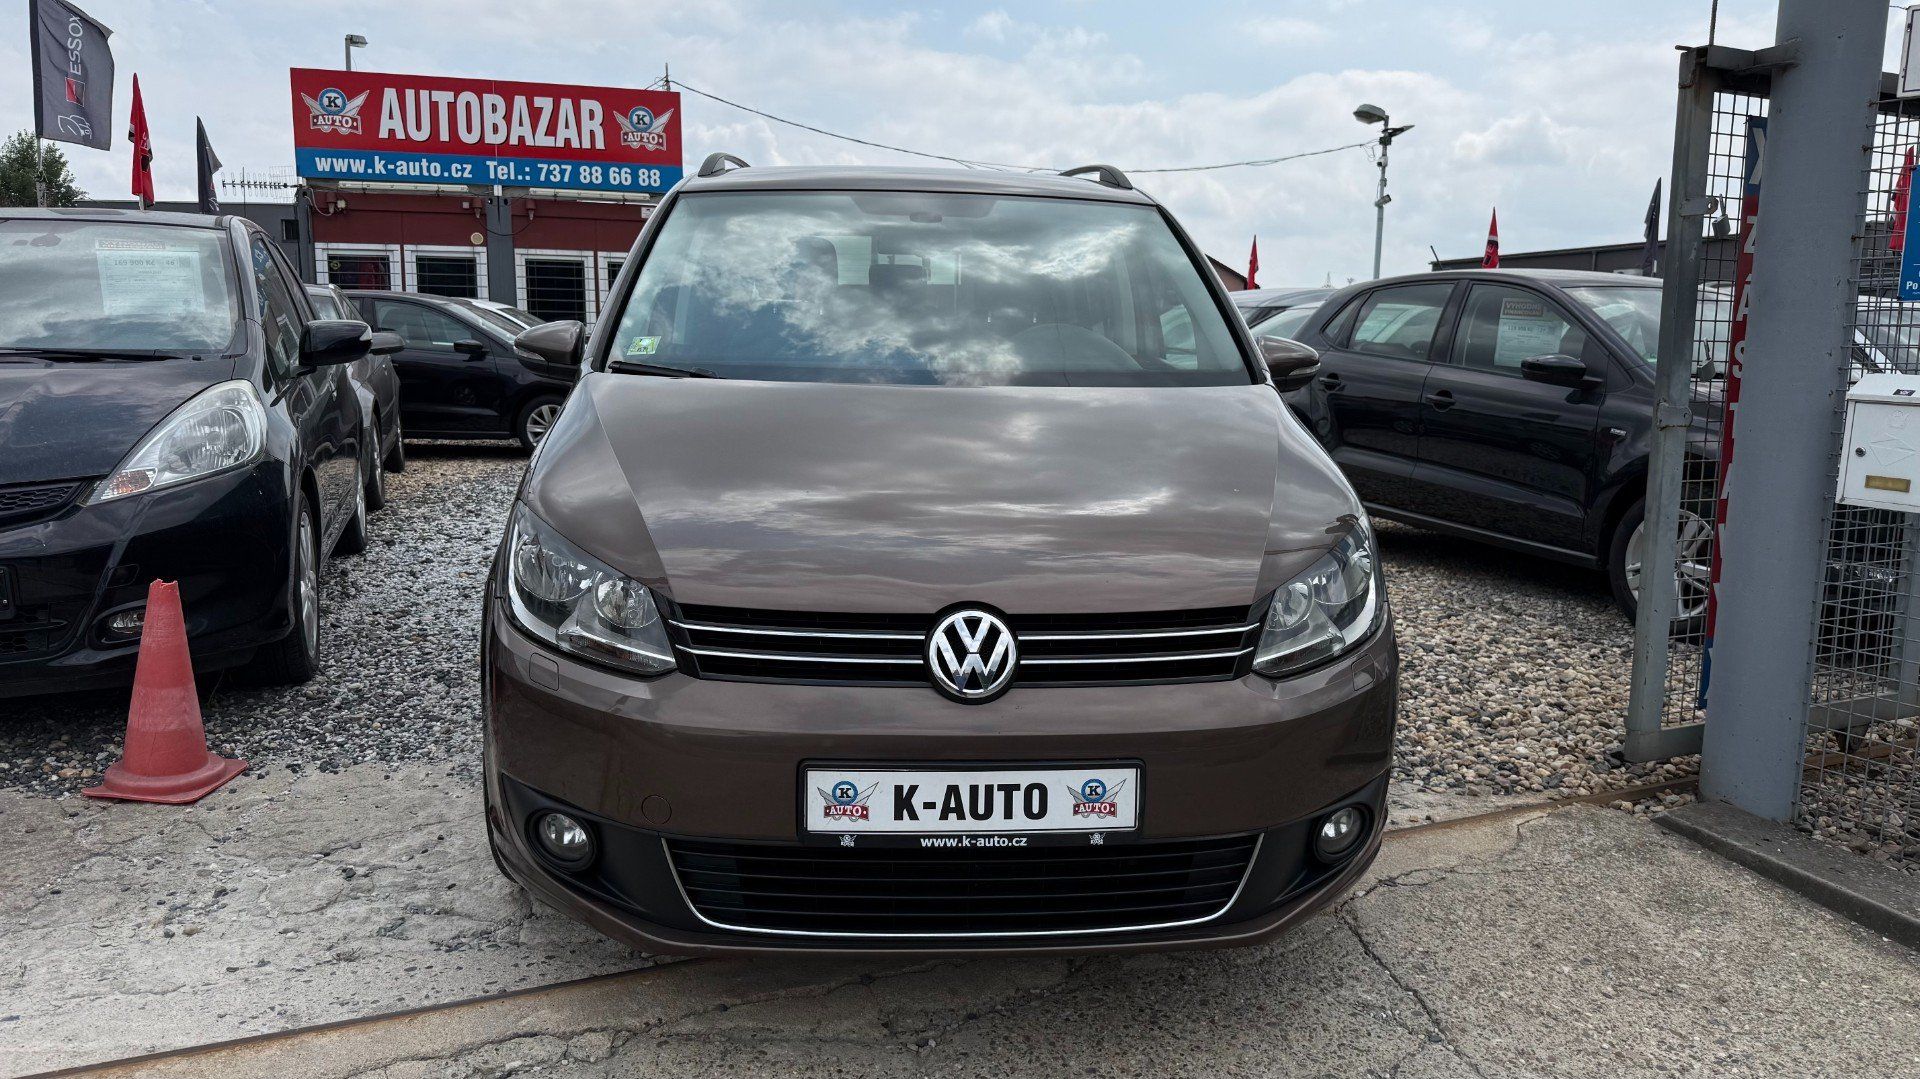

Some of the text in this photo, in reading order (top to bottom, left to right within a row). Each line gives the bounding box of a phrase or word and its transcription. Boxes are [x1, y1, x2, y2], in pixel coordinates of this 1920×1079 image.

[67, 15, 84, 76] ESSOX
[326, 95, 340, 108] K
[316, 113, 352, 128] AUTO
[378, 87, 606, 150] AUTOBAZAR
[635, 113, 648, 126] K
[627, 132, 658, 145] AUTO
[315, 155, 661, 187] www.k-auto.cz Tel.: 737 88 66 88
[838, 787, 852, 799] K
[1087, 784, 1101, 796] K
[893, 782, 1049, 821] K-AUTO
[1077, 802, 1111, 814] AUTO
[828, 804, 862, 817] AUTO
[920, 834, 1028, 848] www.k-auto.cz
